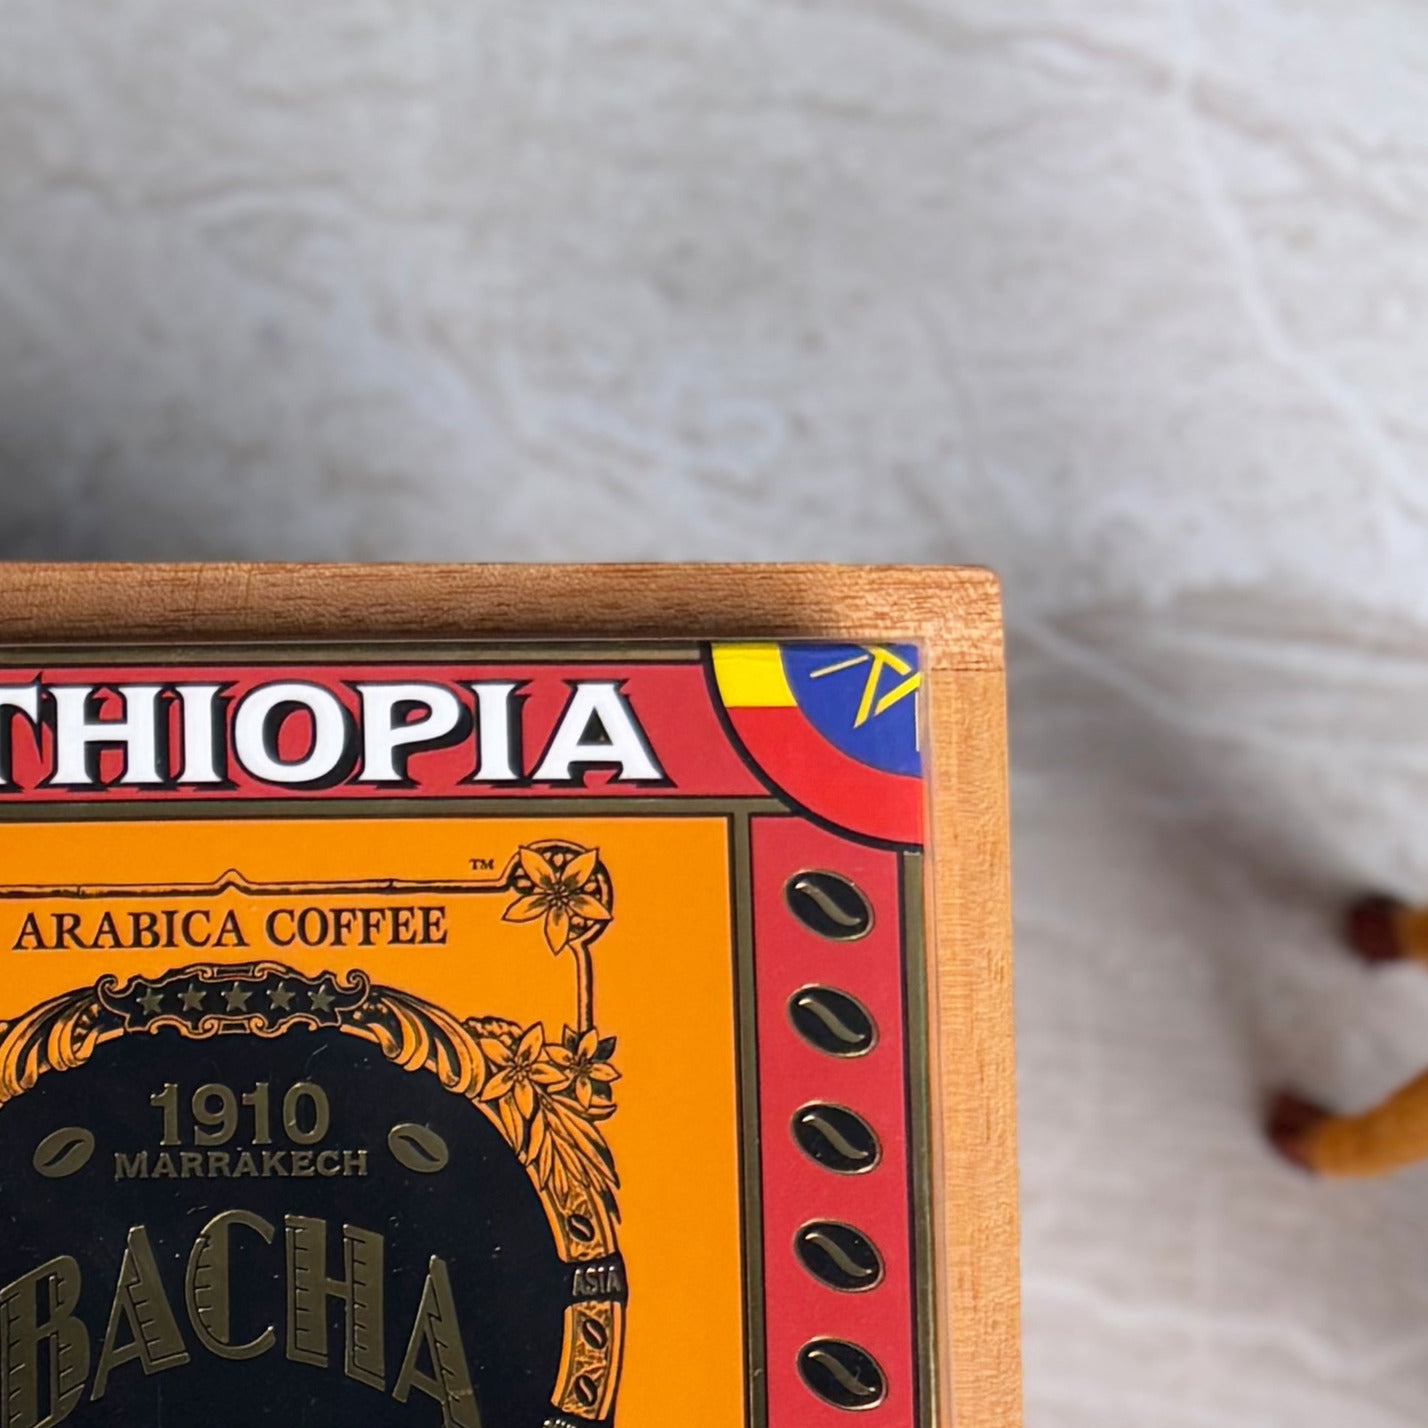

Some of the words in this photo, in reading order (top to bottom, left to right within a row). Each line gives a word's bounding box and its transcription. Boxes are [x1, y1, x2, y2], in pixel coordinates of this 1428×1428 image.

[13, 909, 251, 951] ARABICA
[265, 906, 449, 948] COFFEE
[149, 1082, 331, 1147] 1910
[114, 1149, 368, 1181] MARRAKECH
[572, 1266, 622, 1297] ASIA
